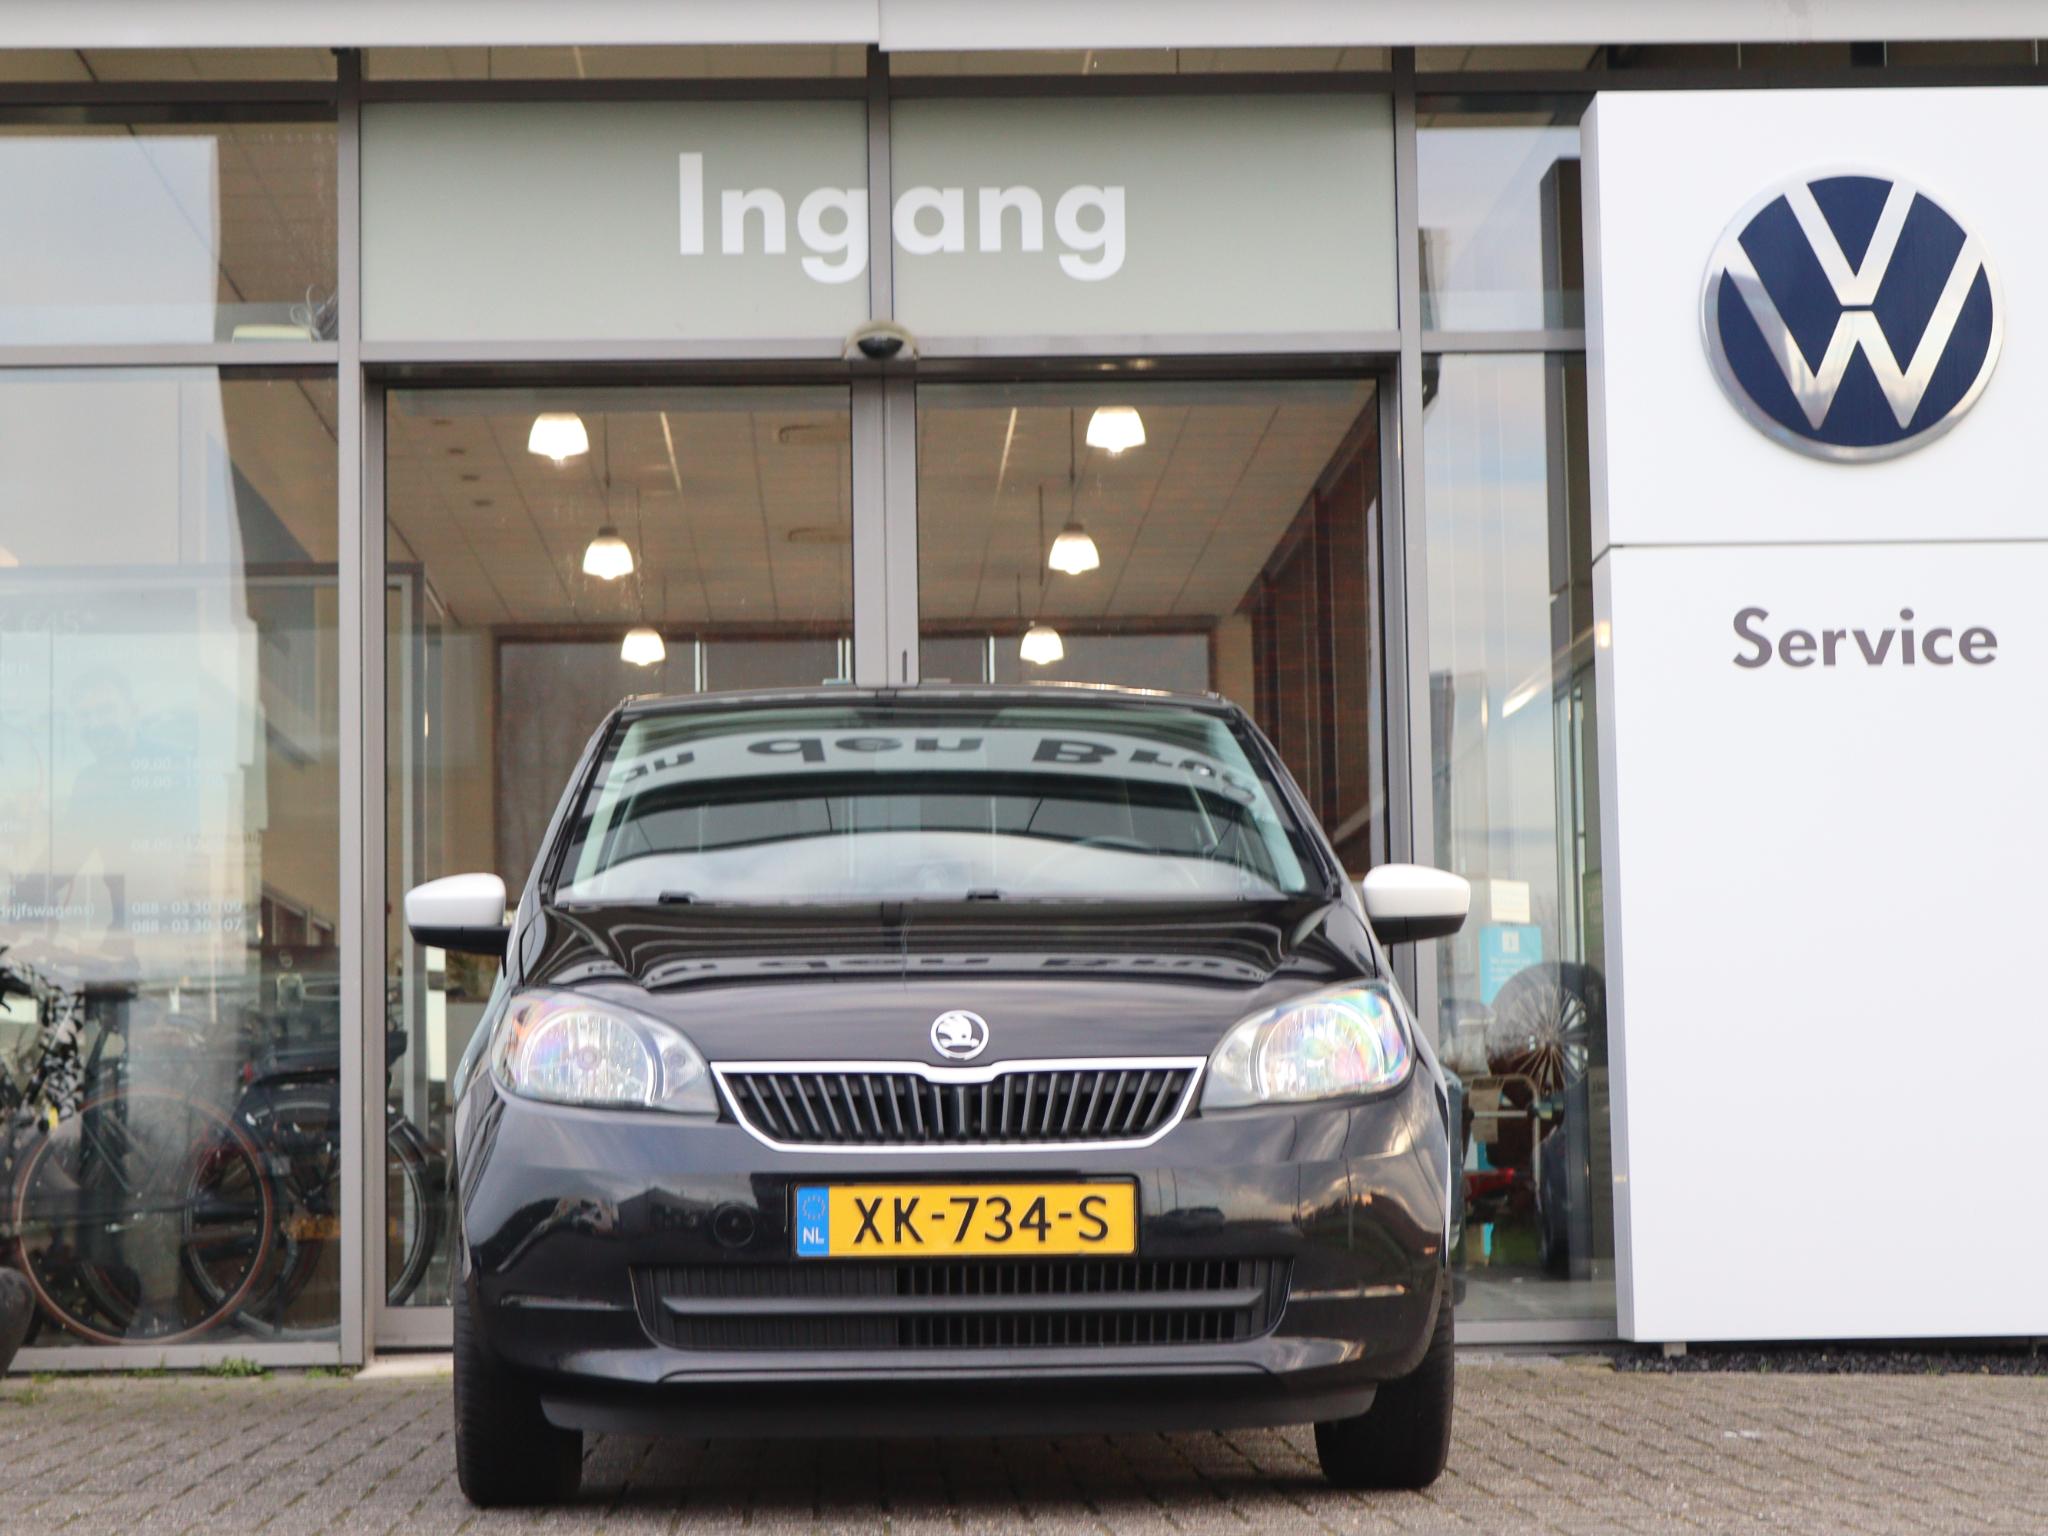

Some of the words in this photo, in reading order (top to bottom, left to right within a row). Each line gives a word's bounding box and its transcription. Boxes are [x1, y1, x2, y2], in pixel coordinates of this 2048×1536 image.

[679, 152, 1127, 283] Ingang
[1732, 606, 1998, 669] Service
[802, 1227, 825, 1245] NL
[853, 1195, 1109, 1244] XK-734-S
